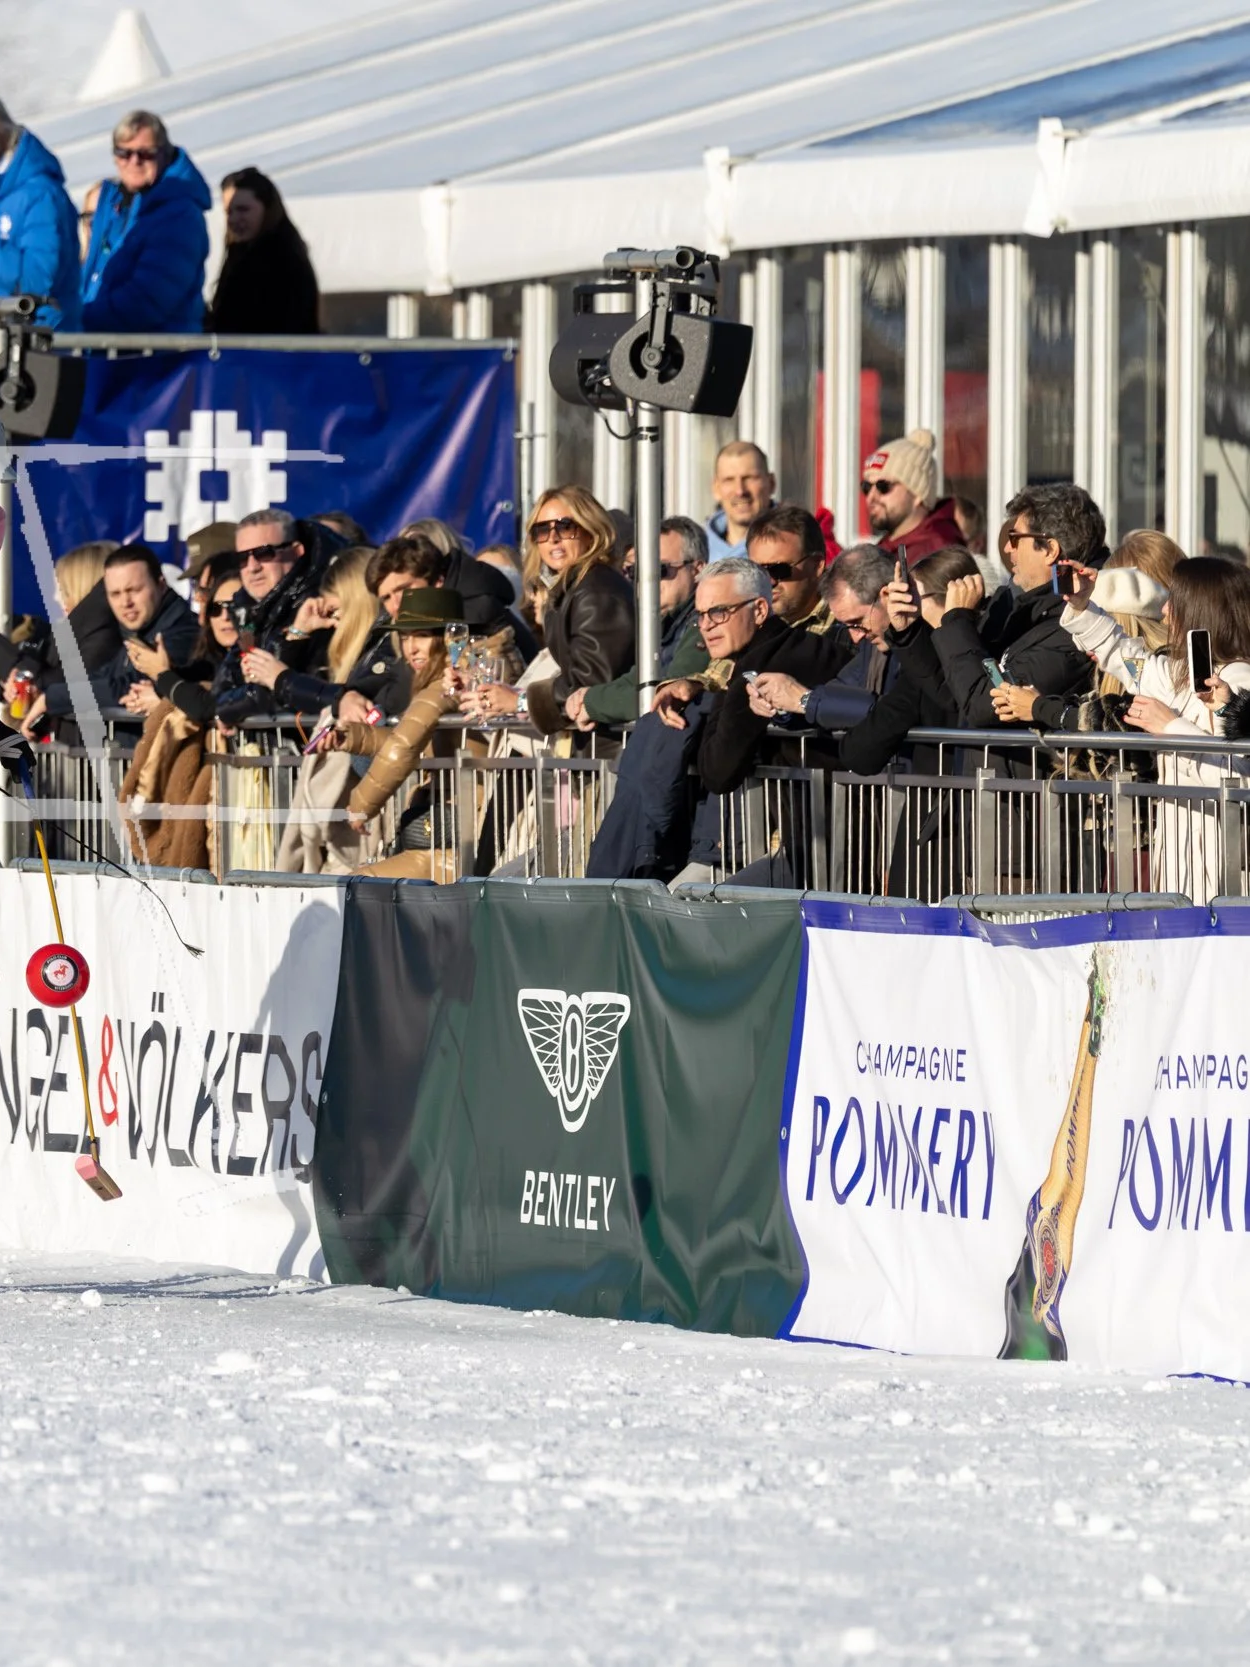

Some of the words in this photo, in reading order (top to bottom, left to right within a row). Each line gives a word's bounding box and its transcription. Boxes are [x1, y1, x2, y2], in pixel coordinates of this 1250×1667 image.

[856, 1040, 967, 1082] CHAMPAGNE
[805, 1095, 996, 1221] POMMERY
[519, 1169, 617, 1232] BENTLEY
